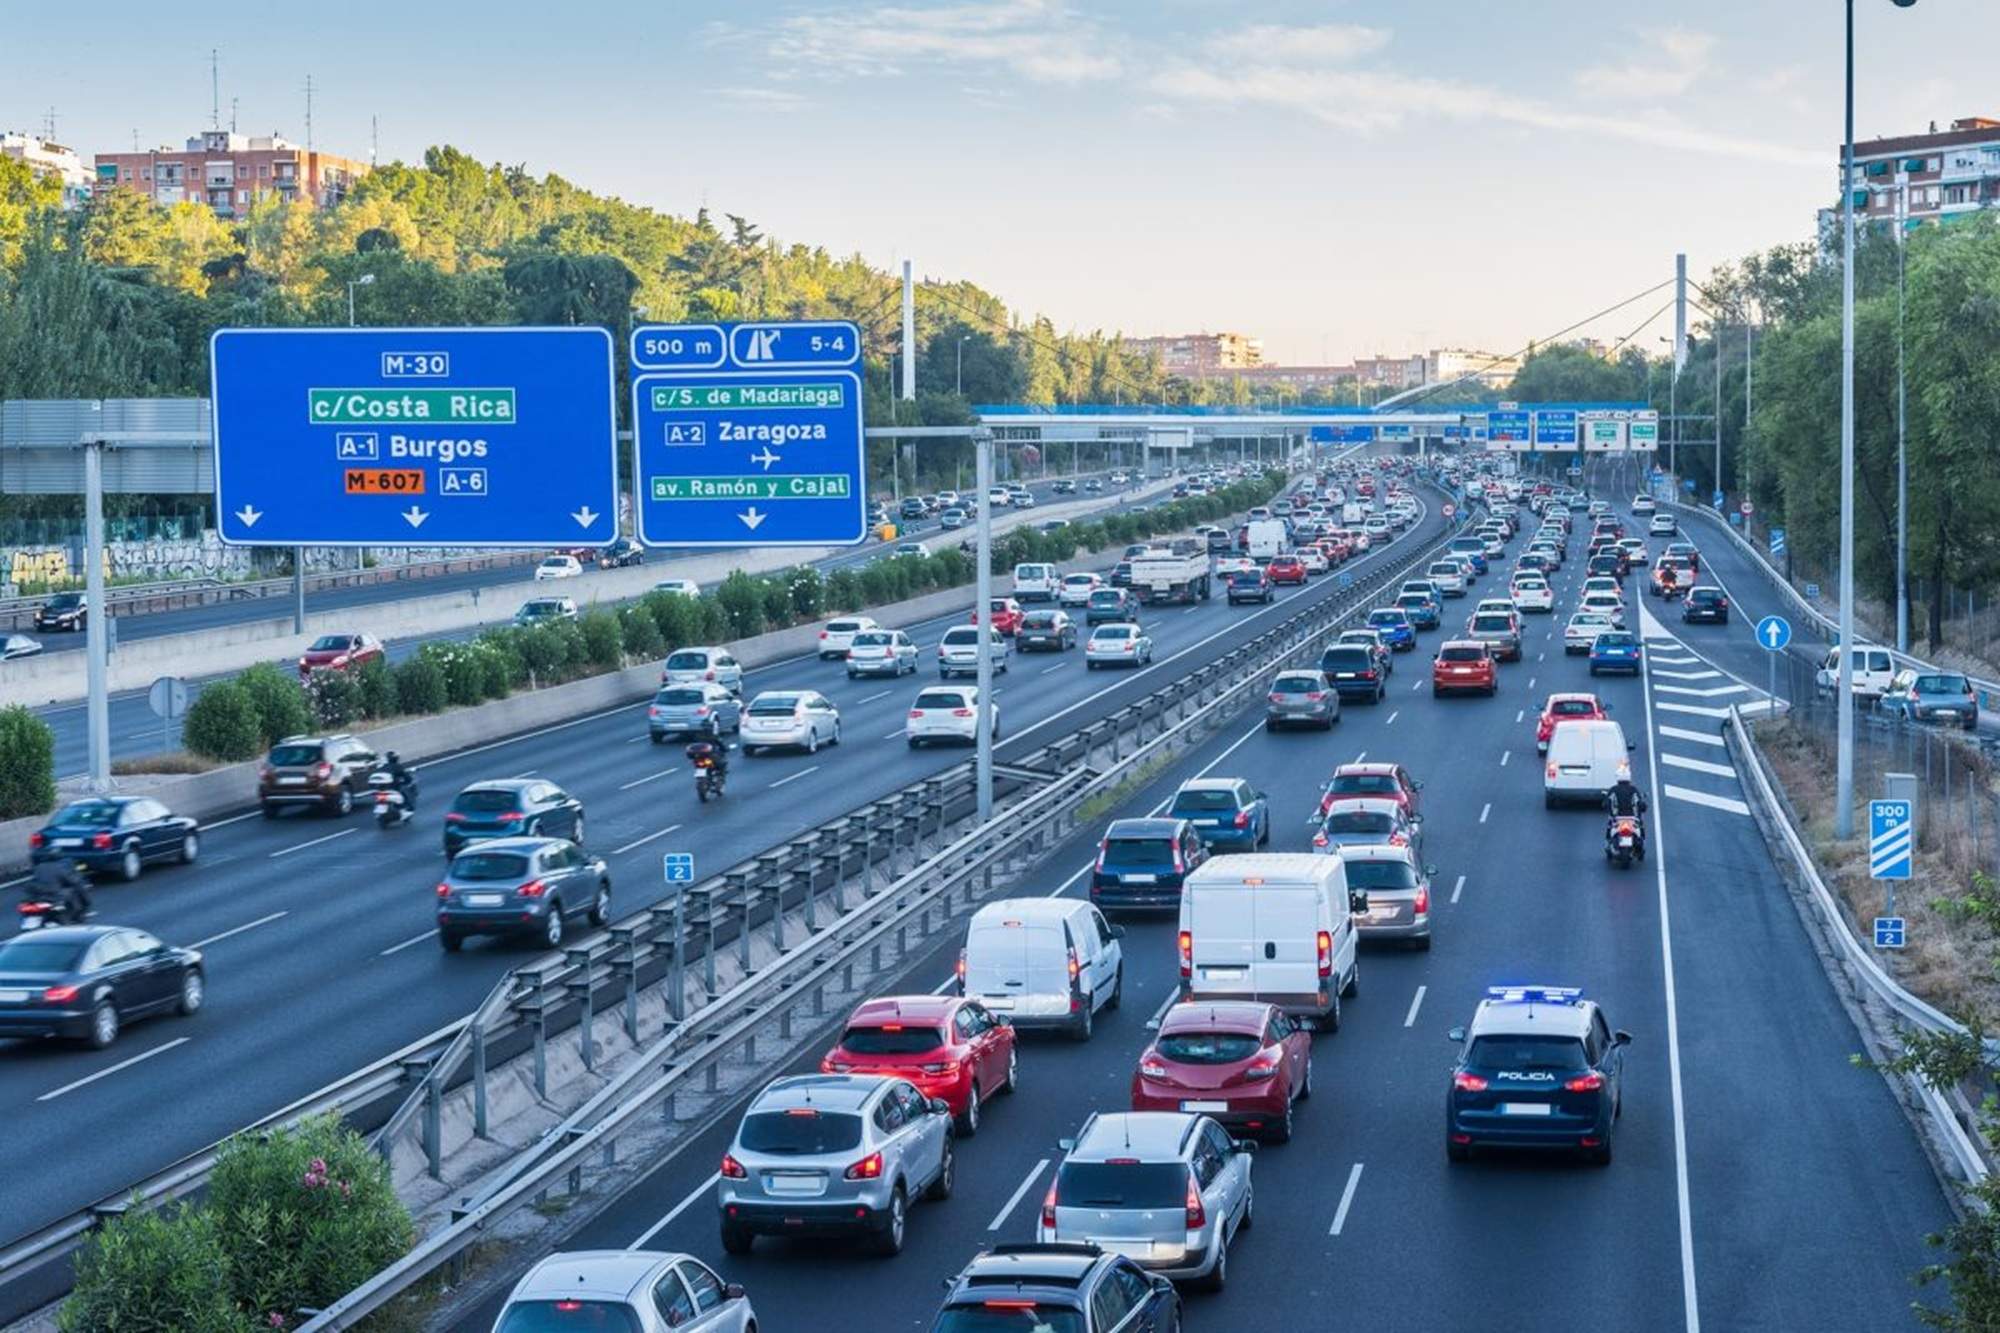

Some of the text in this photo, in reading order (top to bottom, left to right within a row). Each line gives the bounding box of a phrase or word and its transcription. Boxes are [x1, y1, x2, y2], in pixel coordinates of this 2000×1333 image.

[645, 340, 712, 355] 500 m
[811, 336, 845, 351] 5-4
[386, 356, 444, 374] M-30
[655, 387, 840, 407] c/S. de Madariaga
[315, 395, 511, 418] c/Costa Rica
[670, 422, 826, 445] A-2 Zaragoza
[342, 435, 488, 462] A-1 Burgos
[348, 472, 482, 490] M-607 A-6
[656, 477, 846, 498] av. Ramón y Cajal
[1875, 805, 1905, 817] 300
[1885, 818, 1898, 827] m
[674, 867, 684, 879] 2
[1885, 933, 1894, 944] 2
